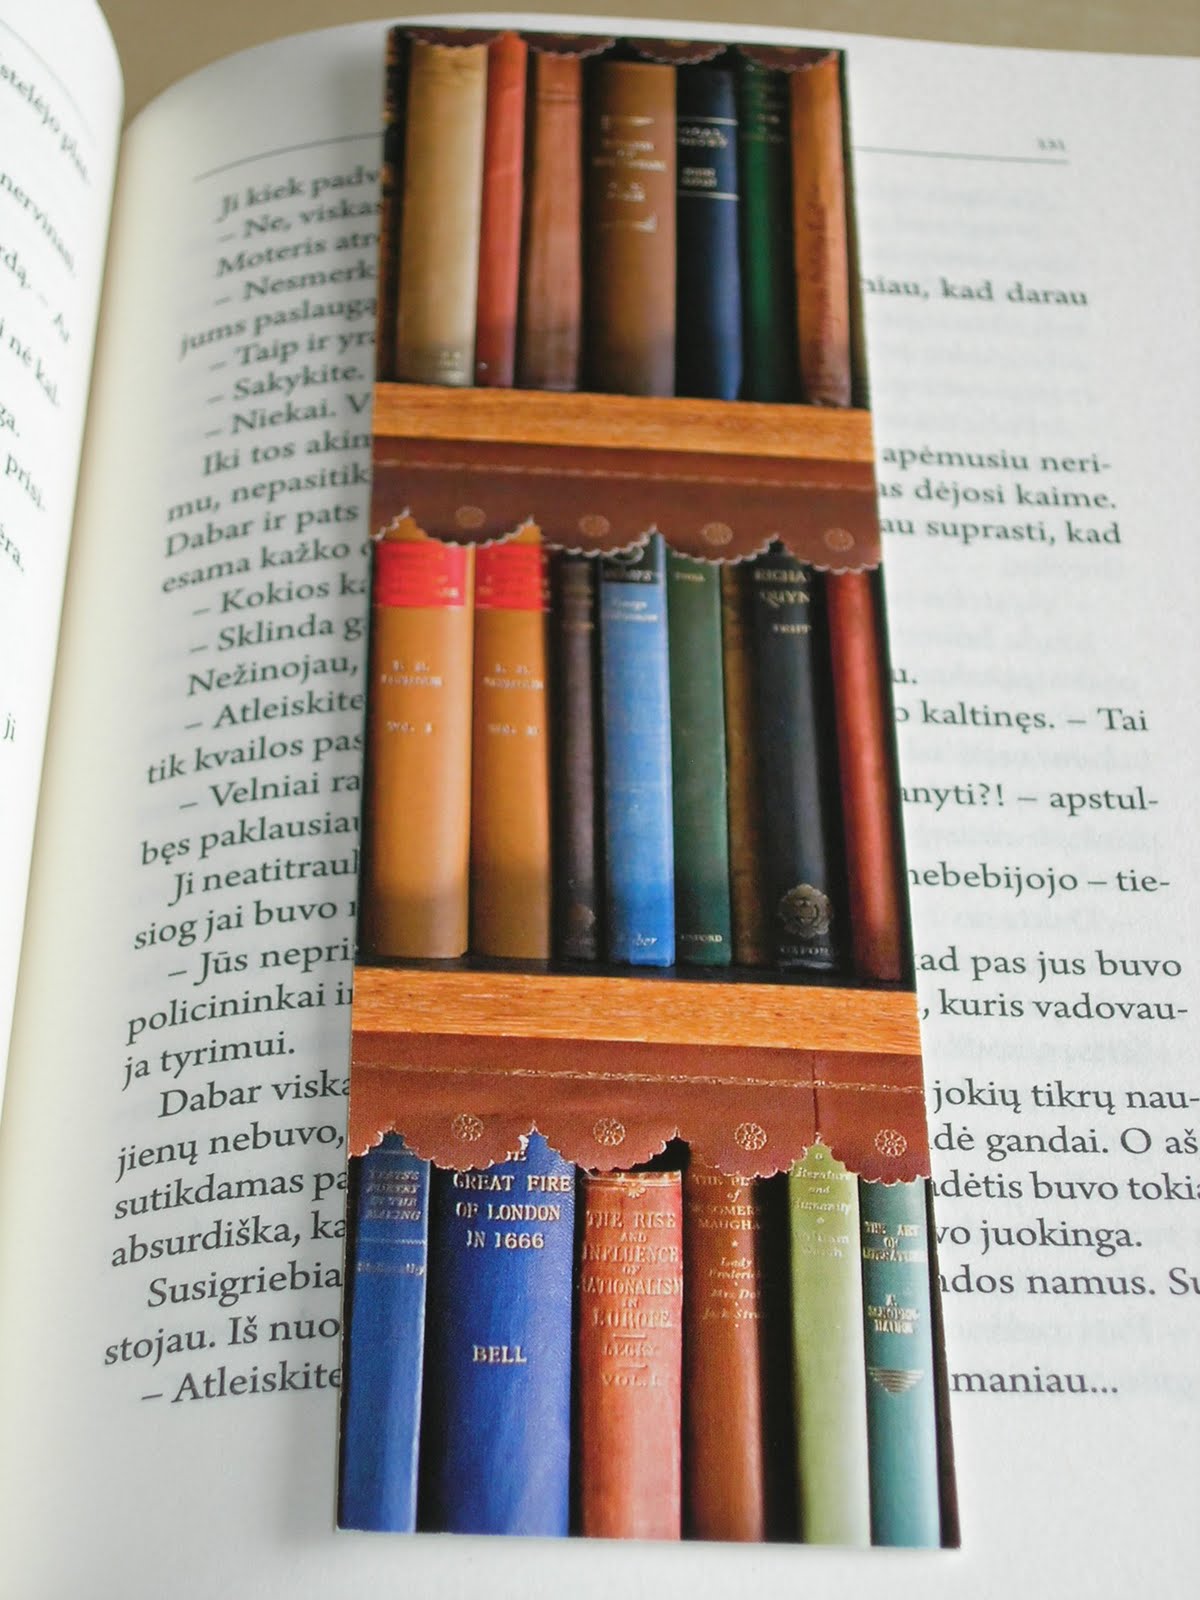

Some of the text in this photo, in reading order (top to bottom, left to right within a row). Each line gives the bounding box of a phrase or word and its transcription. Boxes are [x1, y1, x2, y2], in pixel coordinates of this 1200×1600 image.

[215, 193, 239, 224] Ji
[246, 176, 304, 207] kiek
[213, 237, 326, 277] Moteris
[942, 276, 995, 301] kad
[1006, 280, 1088, 307] darau
[178, 319, 247, 362] jums
[236, 338, 299, 365] Taip
[307, 333, 330, 353] ir
[234, 364, 364, 400] Sakykite.
[232, 398, 336, 434] Niekai.
[203, 448, 240, 476] Iki
[251, 443, 295, 464] tos
[882, 445, 1111, 475] apėmusiu neri-
[167, 462, 370, 523] mu, nepasitik
[915, 477, 1005, 510] dėjosi
[1016, 484, 1117, 510] kaime.
[165, 503, 359, 558] Dabar ir pats
[927, 519, 1056, 546] suprasti,
[1066, 522, 1121, 545] kad
[161, 556, 251, 593] esama
[260, 538, 351, 570] kažko
[220, 581, 330, 613] Kokios
[217, 613, 333, 652] Sklinda
[187, 654, 358, 698] Nežinojau,
[213, 691, 367, 729] Atleiskite
[922, 700, 1055, 734] kaltinęs.
[1097, 707, 1149, 731] Tai
[147, 754, 187, 785] tik
[194, 736, 305, 773] kvailos
[210, 772, 320, 807] Velniai
[1049, 786, 1159, 816] apstul-
[141, 838, 191, 867] bęs
[167, 871, 194, 907] Ji
[908, 861, 1170, 899] nebebijojo tie-
[134, 918, 198, 950] siog
[204, 906, 244, 942] jai
[255, 899, 338, 927] buvo
[193, 937, 358, 986] Jūs nepri
[915, 946, 1182, 983] ad pas jus buvo
[127, 982, 325, 1045] policininkai
[939, 988, 1189, 1021] kuris vadovau-
[122, 1031, 296, 1091] ja tyrimui.
[158, 1080, 262, 1119] Dabar
[933, 1078, 1200, 1115] jokių tikrų nau-
[114, 1122, 345, 1183] jienų nebuvo,
[987, 1125, 1109, 1162] gandai.
[1120, 1127, 1153, 1155] O
[1165, 1128, 1199, 1155] aš
[114, 1171, 304, 1220] sutikdamas
[453, 1172, 571, 1193] GREAT FIRE
[727, 1188, 742, 1203] of
[1029, 1171, 1119, 1201] buvo
[455, 1201, 561, 1221] OF LONDON
[586, 1210, 623, 1229] THE
[633, 1210, 677, 1229] RISE
[111, 1213, 302, 1267] absurdiška,
[466, 1229, 545, 1249] IN 1666
[582, 1244, 679, 1263] INFLUENCE
[620, 1231, 647, 1243] AND
[981, 1218, 1143, 1258] juokinga.
[147, 1260, 343, 1308] Susigriebia
[621, 1265, 641, 1276] OF
[1027, 1273, 1156, 1296] namus.
[104, 1314, 341, 1367] stojau. Iš nuo
[472, 1345, 527, 1363] BELL
[171, 1360, 341, 1403] Atleiskite
[951, 1366, 1119, 1394] maniau...
